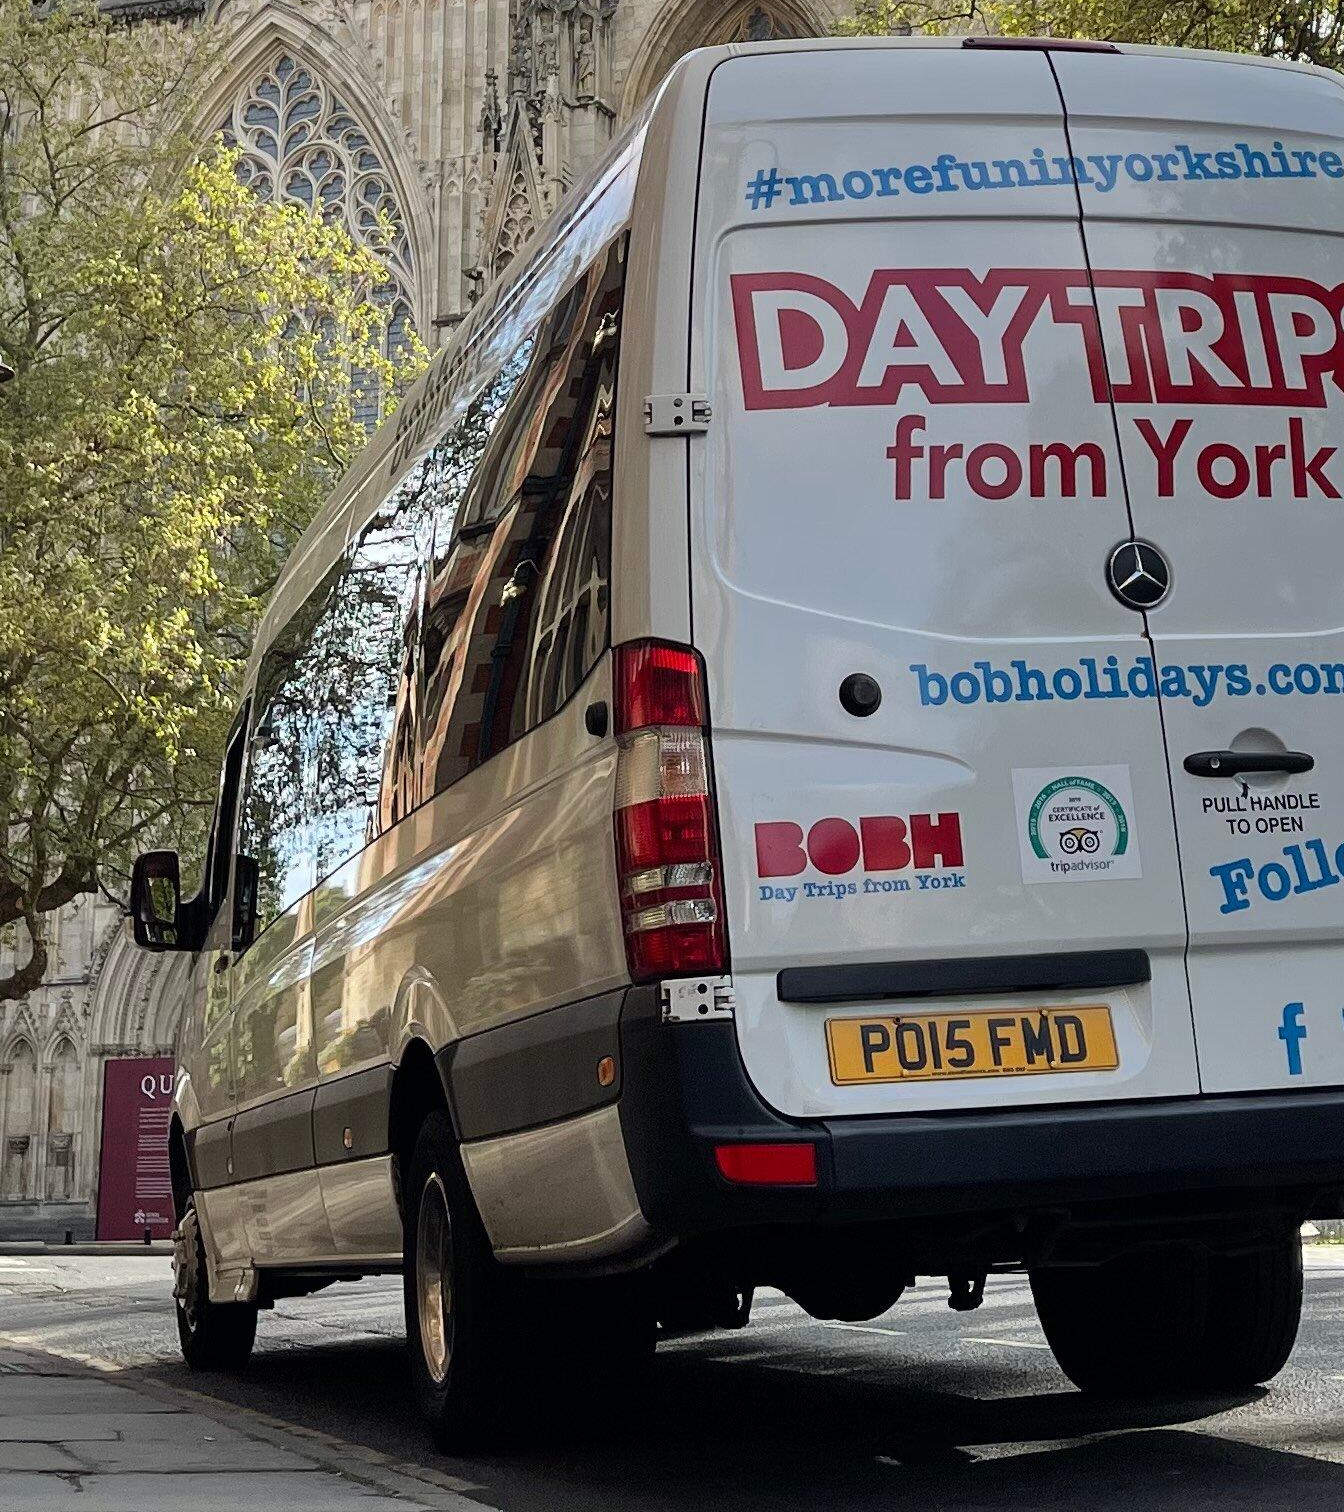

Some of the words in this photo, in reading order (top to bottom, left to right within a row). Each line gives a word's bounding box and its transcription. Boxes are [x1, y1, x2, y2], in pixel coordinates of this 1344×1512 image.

[746, 142, 1344, 209] #morefuninyorkshire
[736, 274, 1036, 402] DAY
[887, 415, 1107, 500] from
[1133, 417, 1341, 499] York
[1048, 811, 1106, 822] EXCELLENCE
[1052, 805, 1093, 814] CERTIFICATE
[1202, 797, 1247, 813] PULL
[1250, 793, 1321, 811] HANDLE
[1226, 818, 1251, 835] TO
[1255, 816, 1304, 833] OPEN
[754, 812, 964, 878] BOBH
[1050, 859, 1112, 874] tripadvisor
[759, 885, 799, 902] Day
[803, 881, 857, 900] Trips
[862, 878, 911, 894] from
[915, 873, 966, 890] York
[860, 1020, 975, 1074] PO15
[987, 1015, 1088, 1070] FMD
